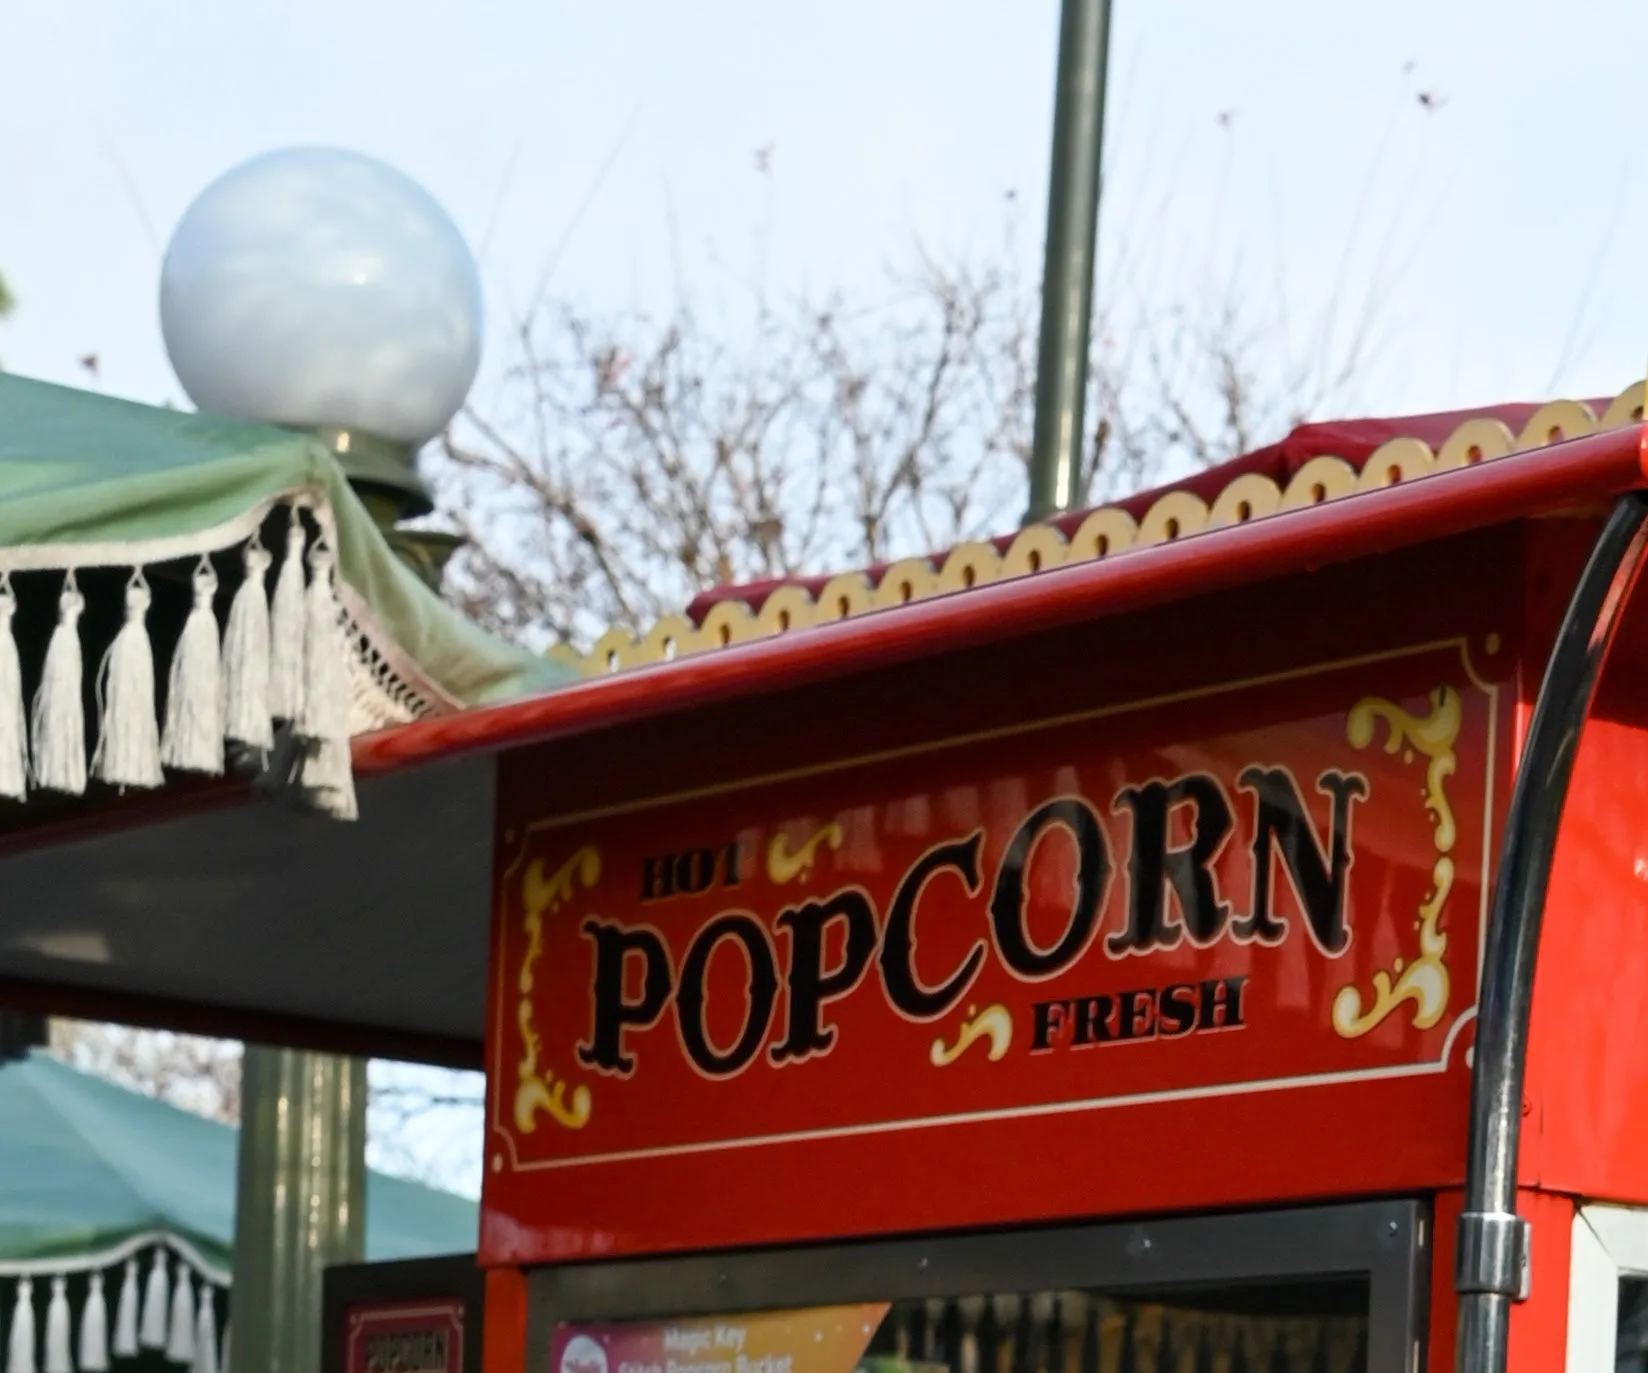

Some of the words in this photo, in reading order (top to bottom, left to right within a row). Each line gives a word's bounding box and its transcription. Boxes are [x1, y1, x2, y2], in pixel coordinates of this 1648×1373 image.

[641, 845, 744, 903] HOT
[577, 764, 1367, 1077] POPCORN
[1029, 977, 1248, 1054] FRESH
[664, 1326, 711, 1356] Magic
[714, 1324, 747, 1350] Key
